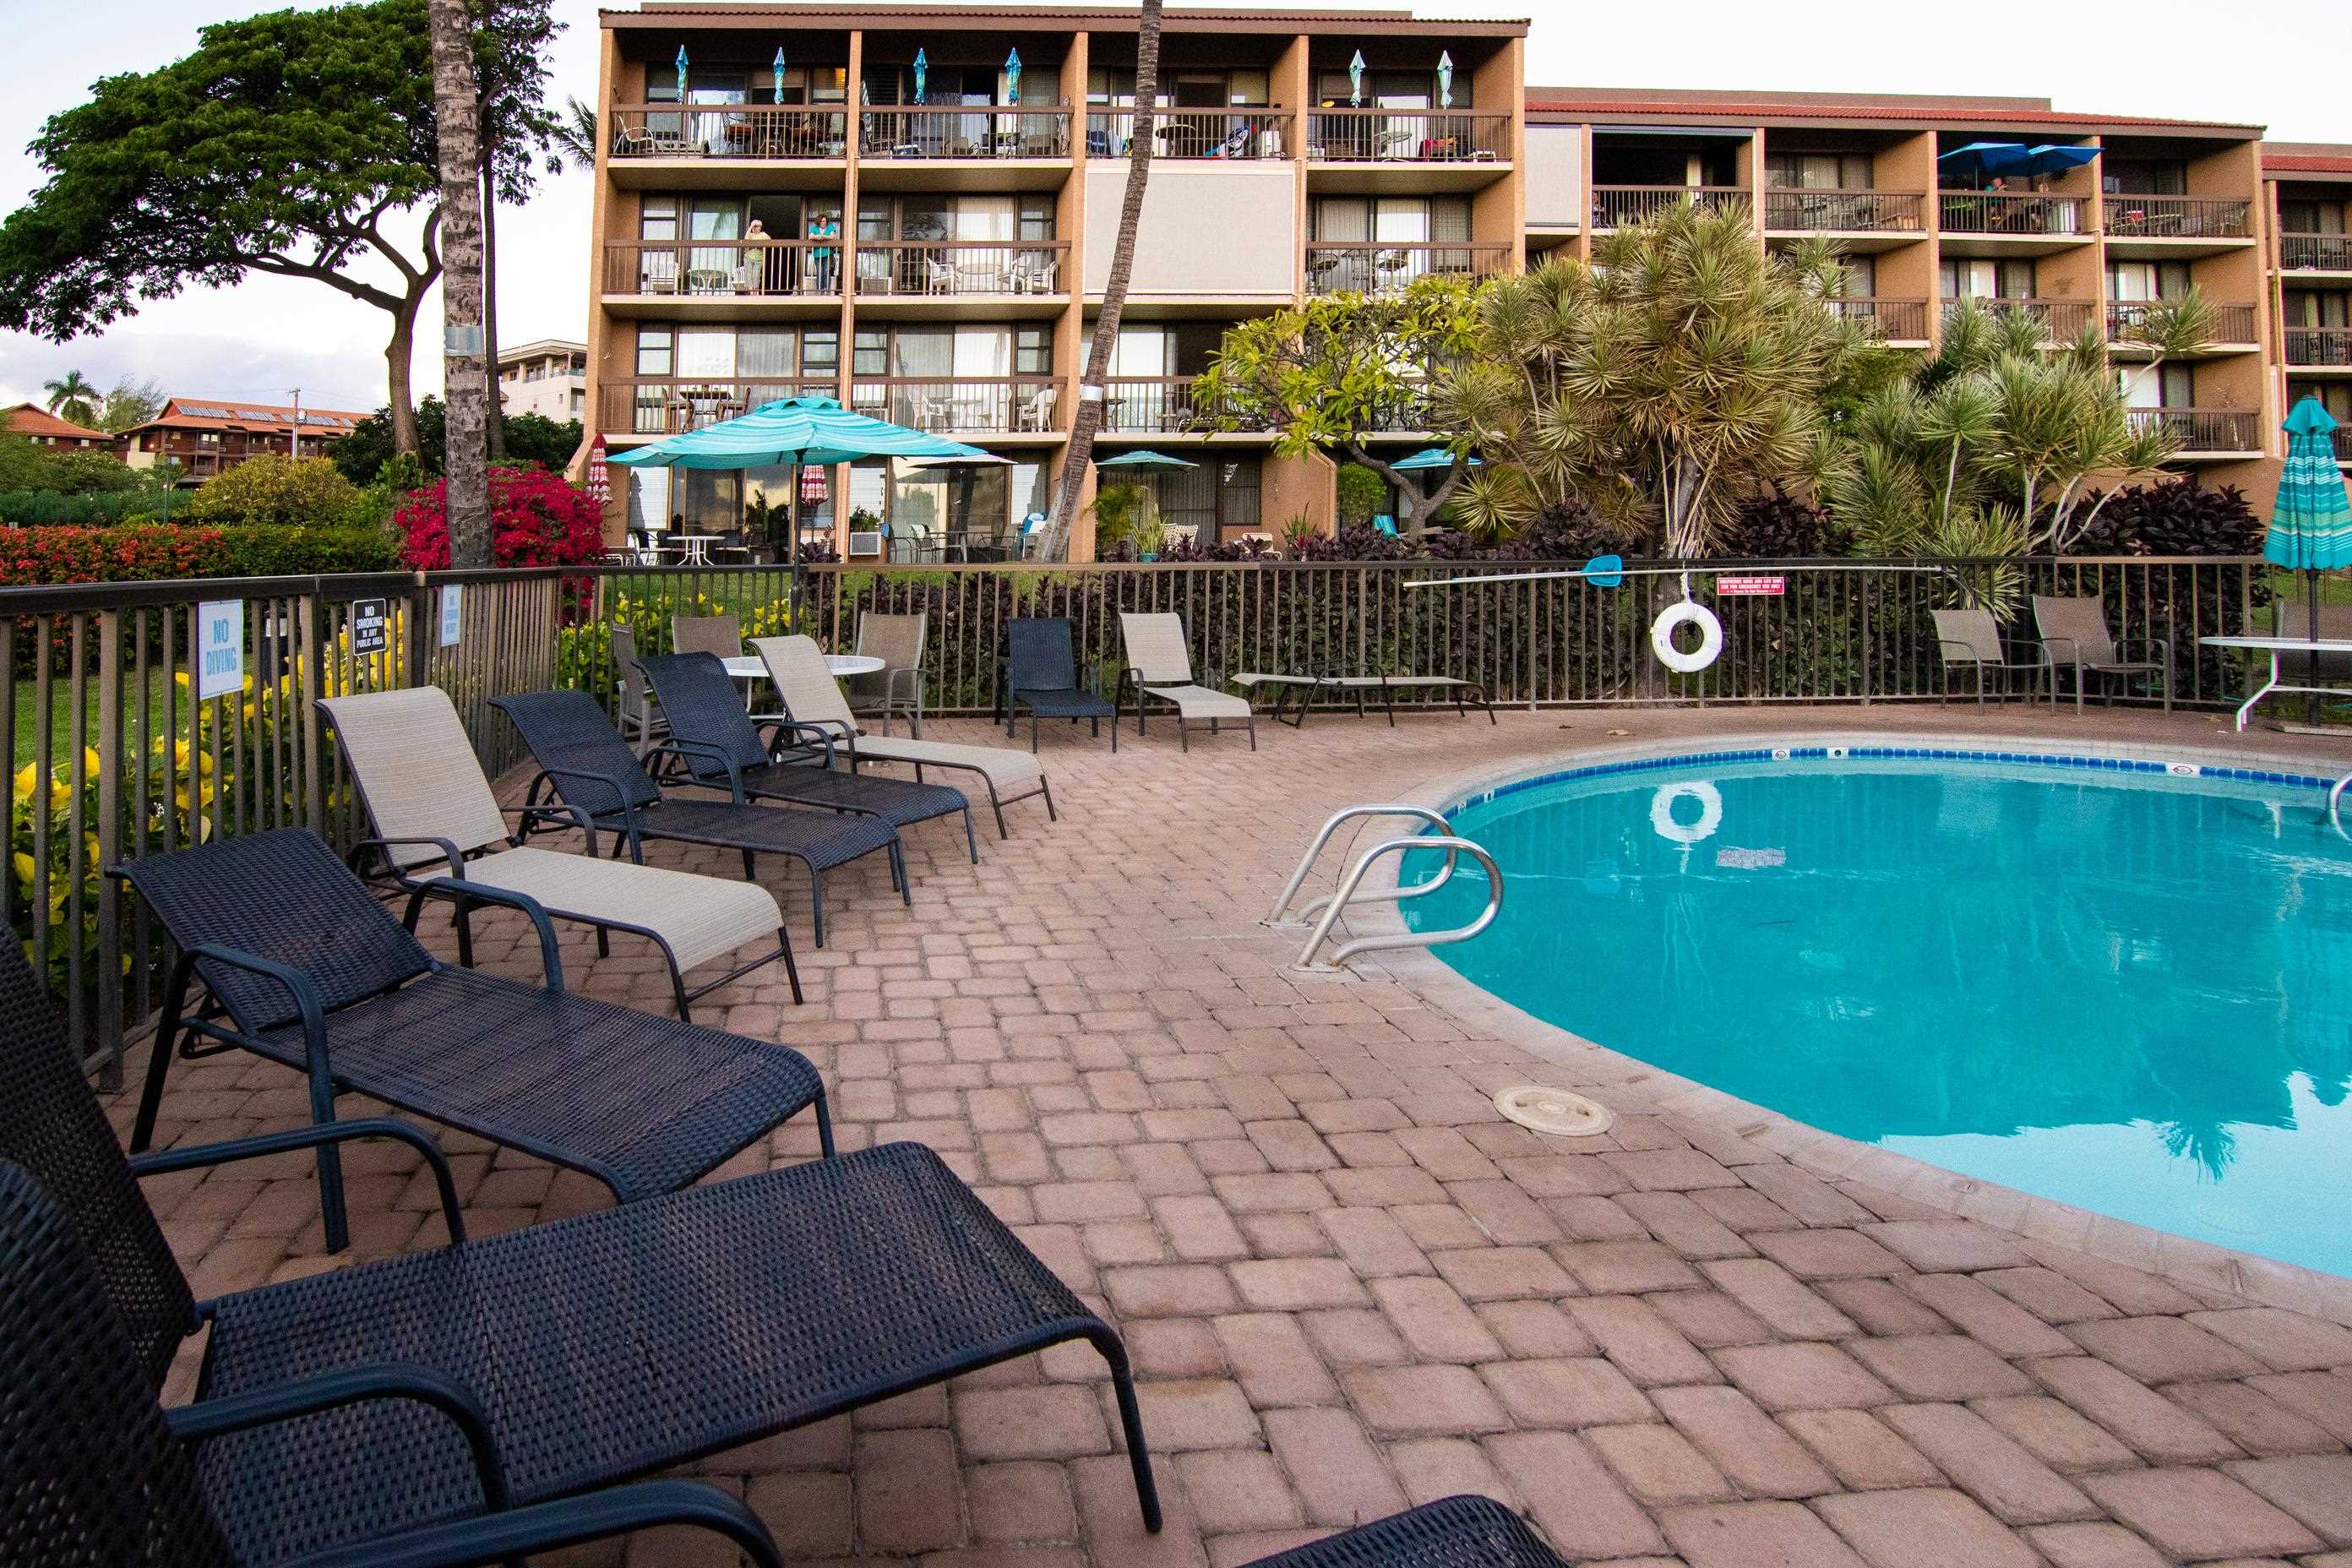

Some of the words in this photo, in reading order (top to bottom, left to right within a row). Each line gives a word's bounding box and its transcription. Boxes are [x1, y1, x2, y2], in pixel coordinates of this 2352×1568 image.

[365, 606, 374, 617] NO
[357, 616, 384, 629] SMOKING
[214, 618, 229, 645] NO
[368, 628, 378, 637] ANY
[357, 638, 372, 648] PUBLIC
[372, 636, 384, 646] AREA
[206, 646, 237, 676] DIVING
